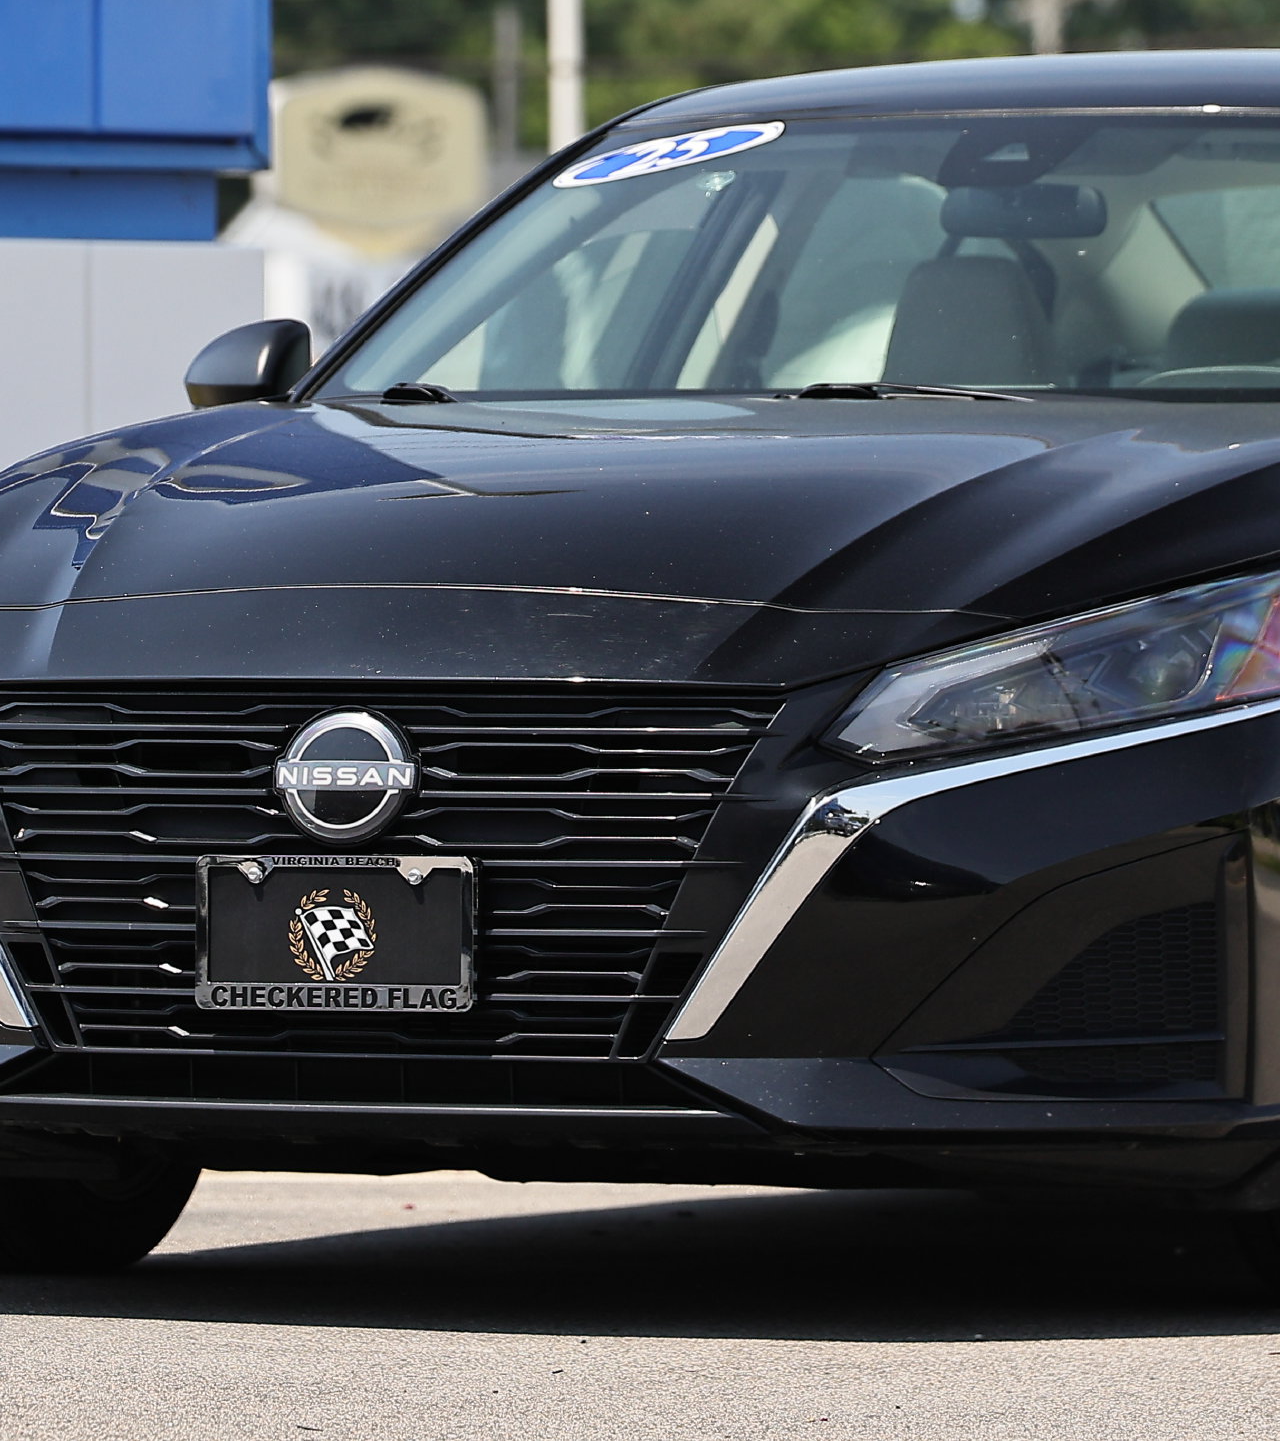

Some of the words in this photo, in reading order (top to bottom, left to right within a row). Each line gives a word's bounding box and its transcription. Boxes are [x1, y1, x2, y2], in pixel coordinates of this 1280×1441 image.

[278, 766, 412, 786] NISSAN
[271, 856, 340, 866] VIRGINIA
[345, 857, 397, 867] BEACH
[211, 986, 378, 1008] CHECKERED
[389, 987, 457, 1009] FLAG
